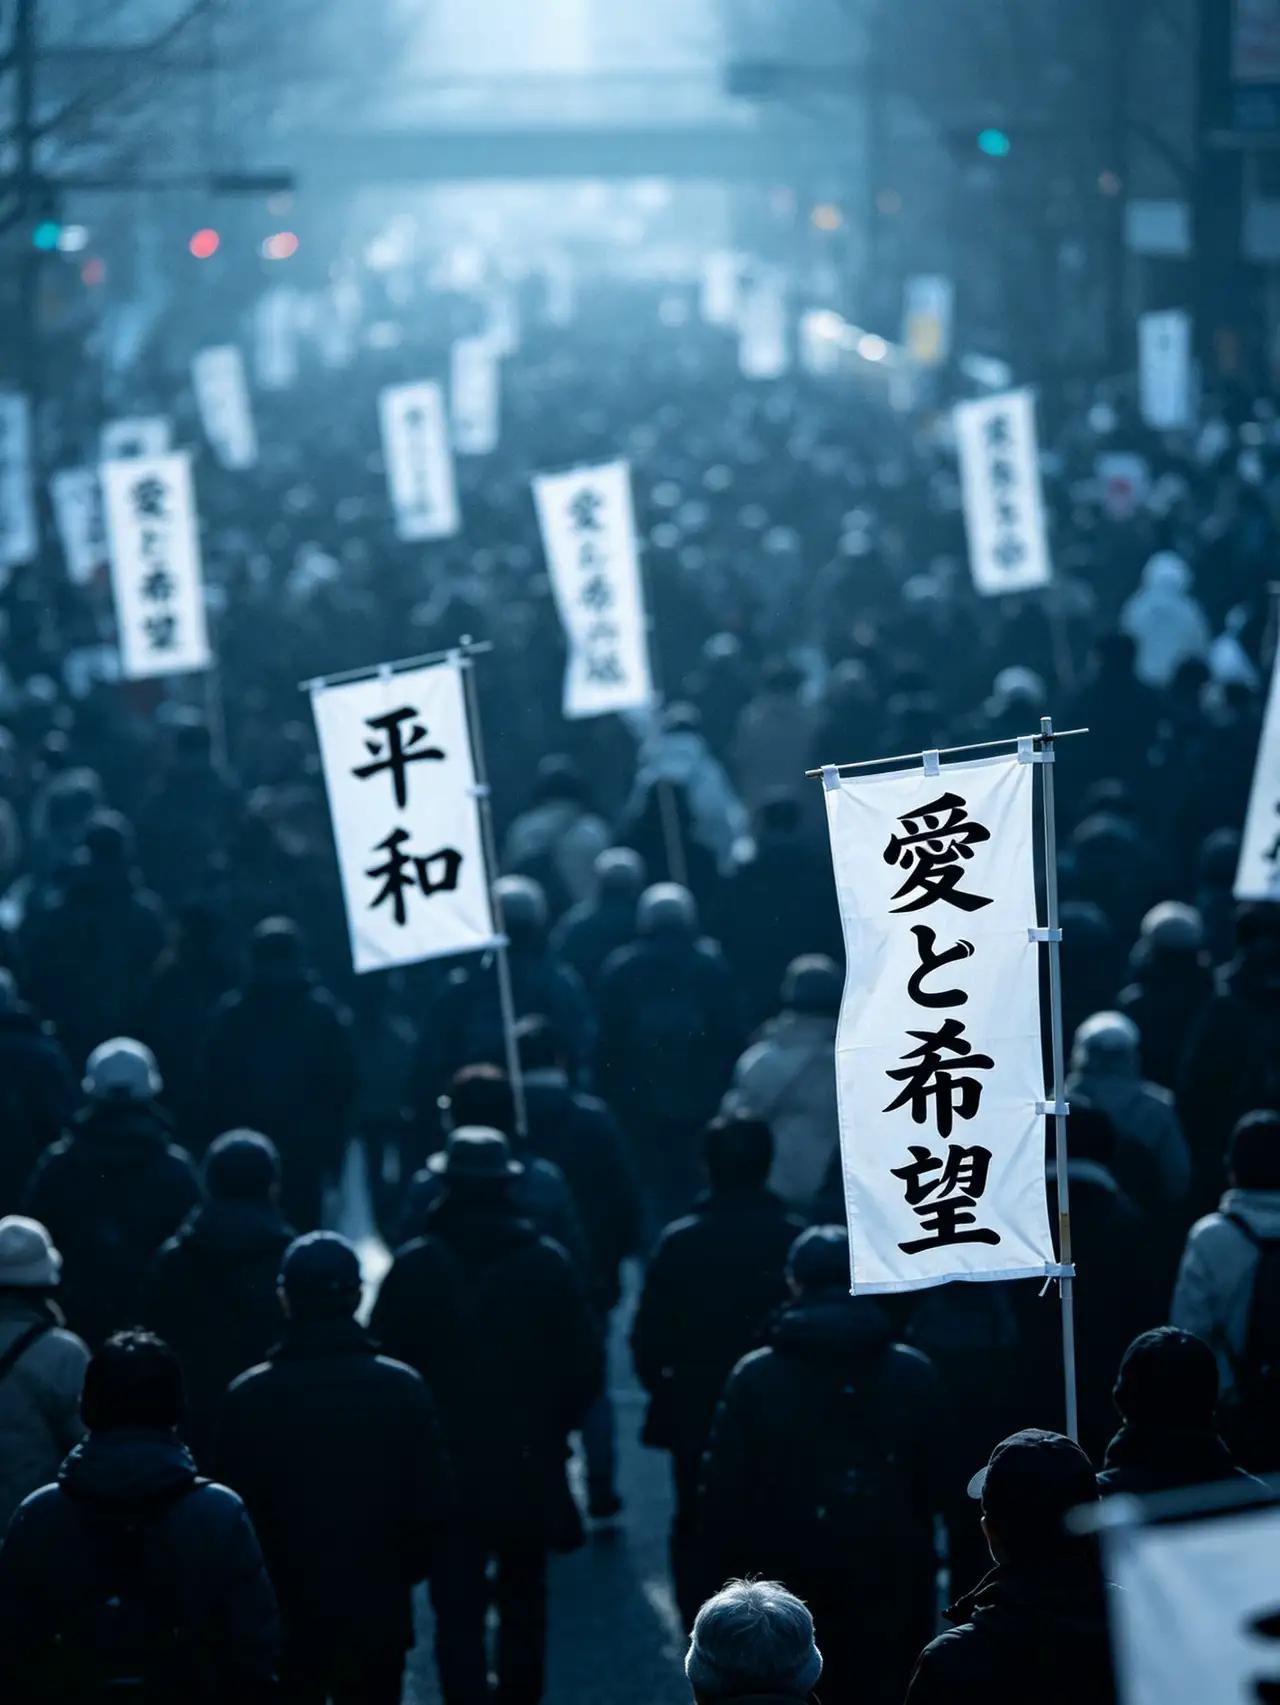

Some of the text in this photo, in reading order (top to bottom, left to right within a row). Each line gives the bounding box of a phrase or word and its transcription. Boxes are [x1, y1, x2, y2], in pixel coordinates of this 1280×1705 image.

[352, 706, 463, 926] 平和
[882, 792, 1001, 1255] 愛と希望
